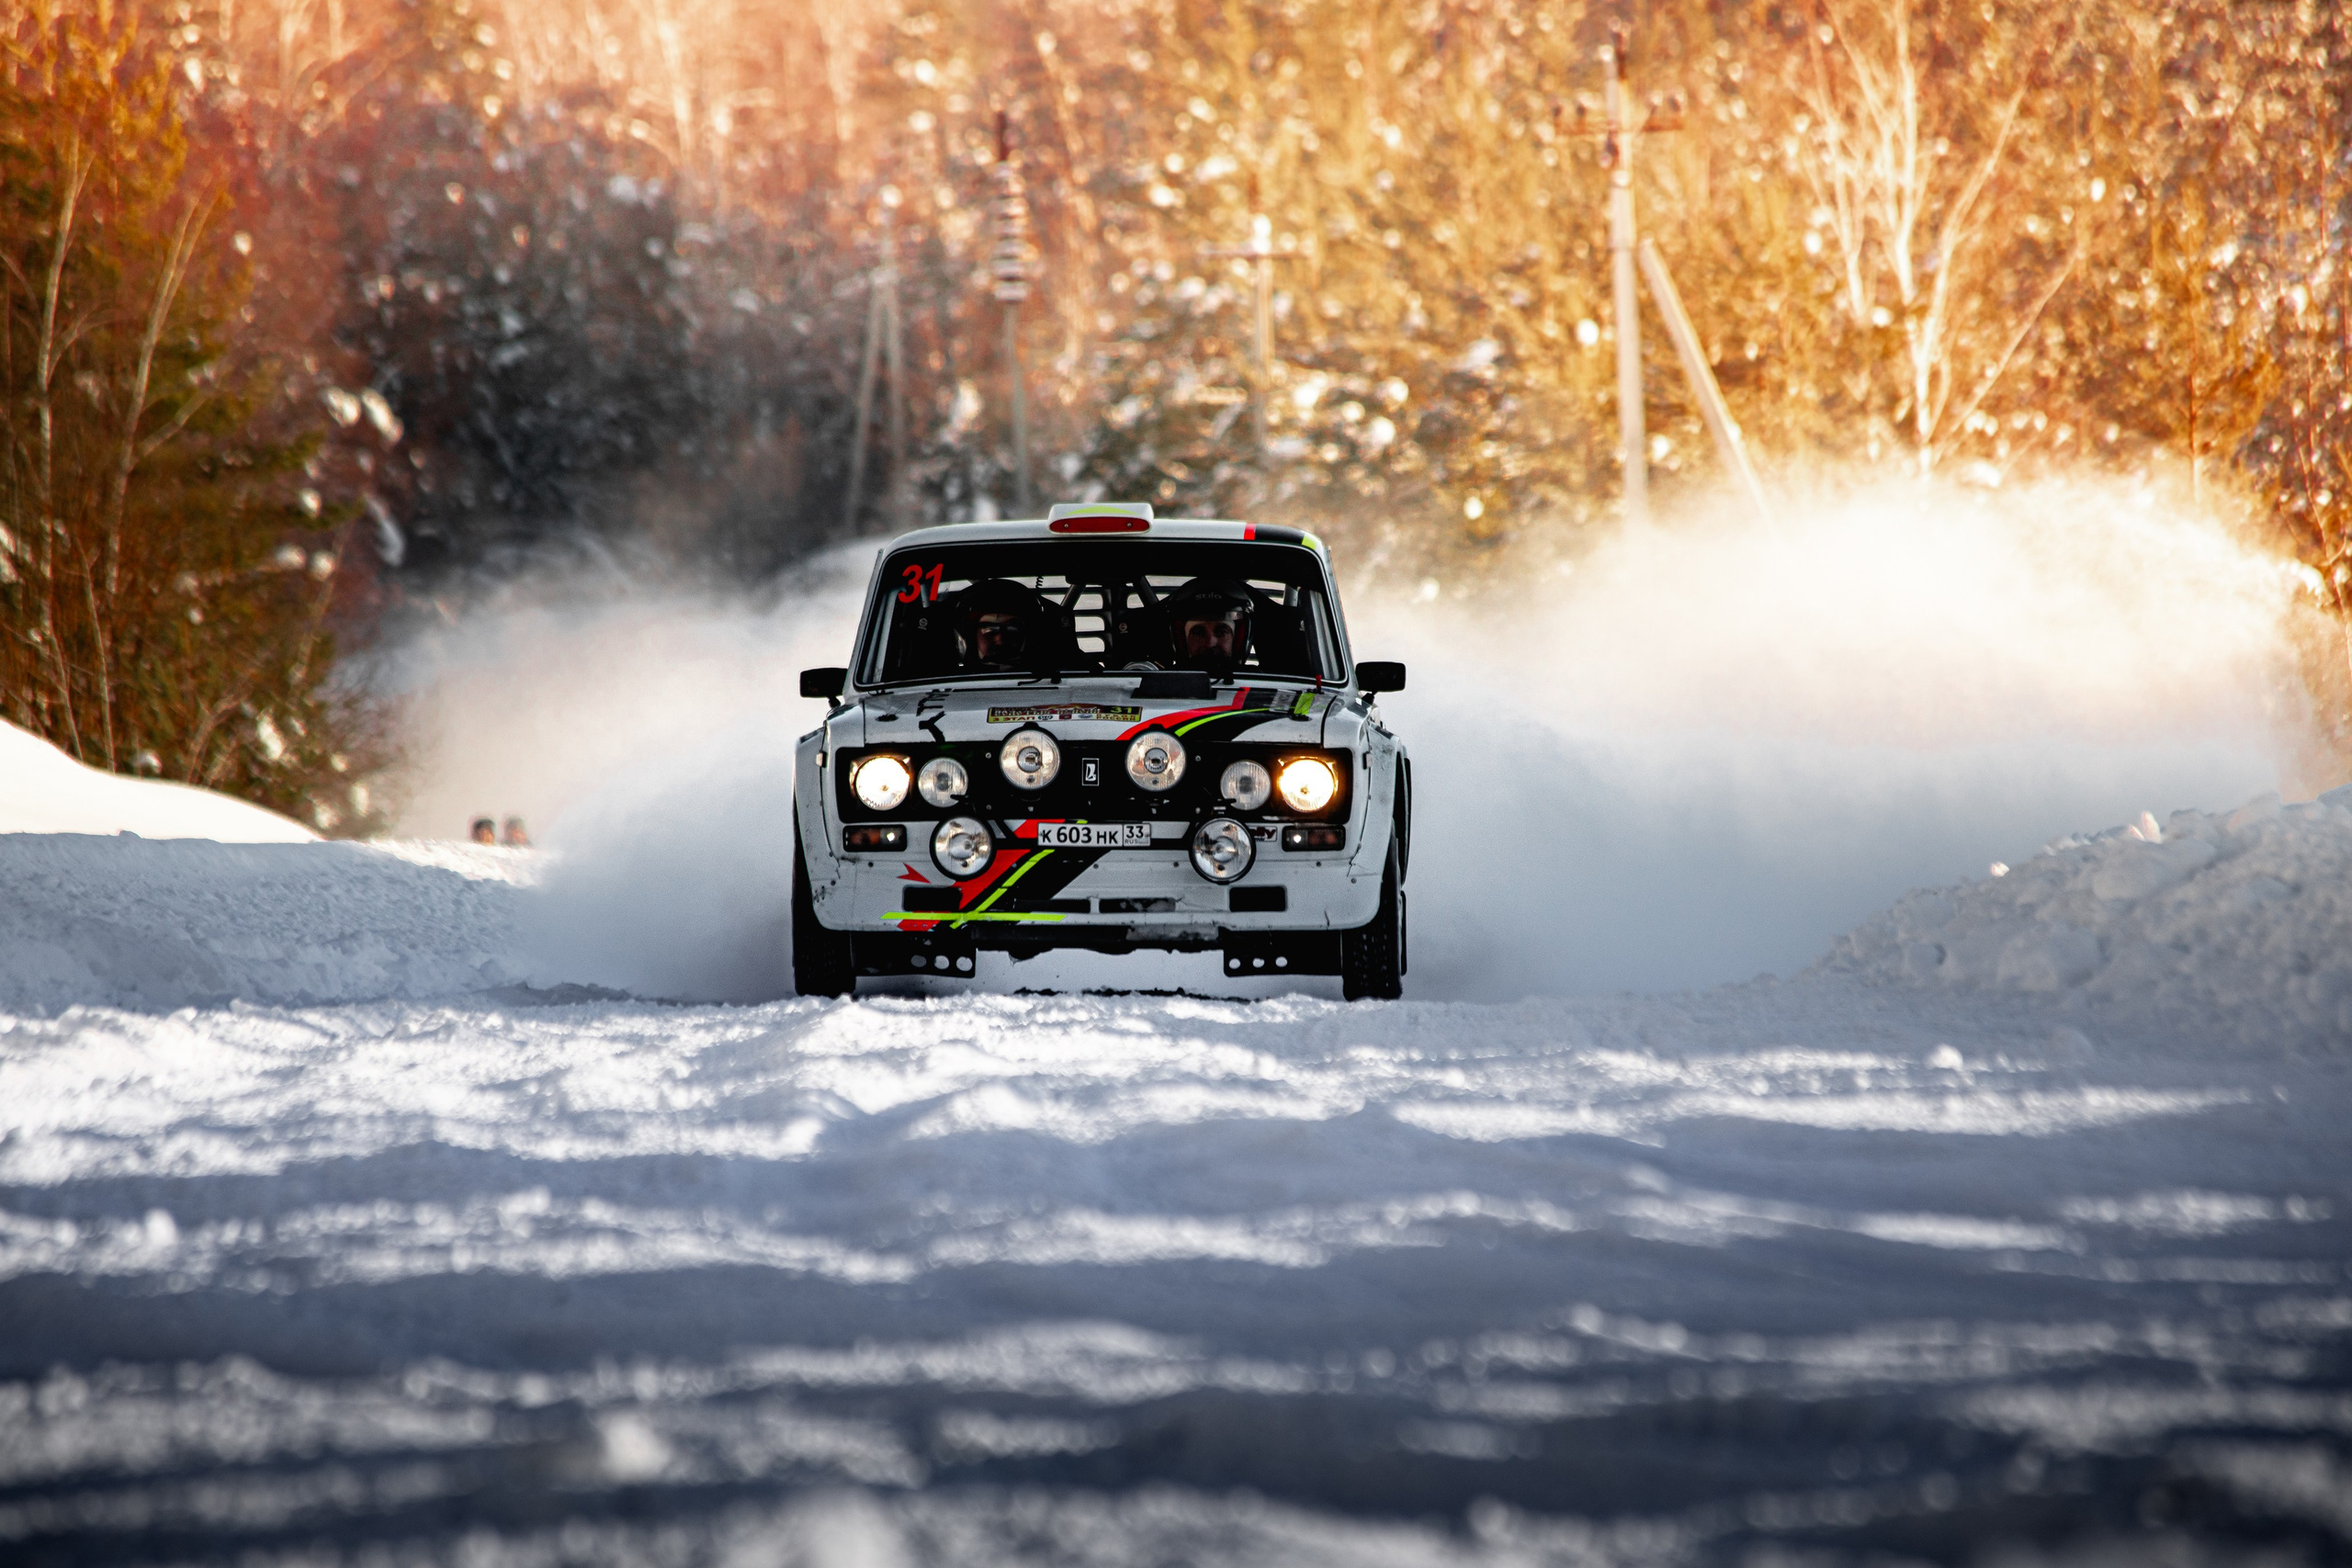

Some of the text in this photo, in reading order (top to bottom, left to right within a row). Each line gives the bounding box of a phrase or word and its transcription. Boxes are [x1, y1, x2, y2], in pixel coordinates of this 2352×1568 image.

[898, 563, 944, 604] 31
[1110, 705, 1132, 714] 31
[1057, 827, 1091, 843] 603
[1097, 830, 1118, 844] НК
[1125, 826, 1144, 839] 33
